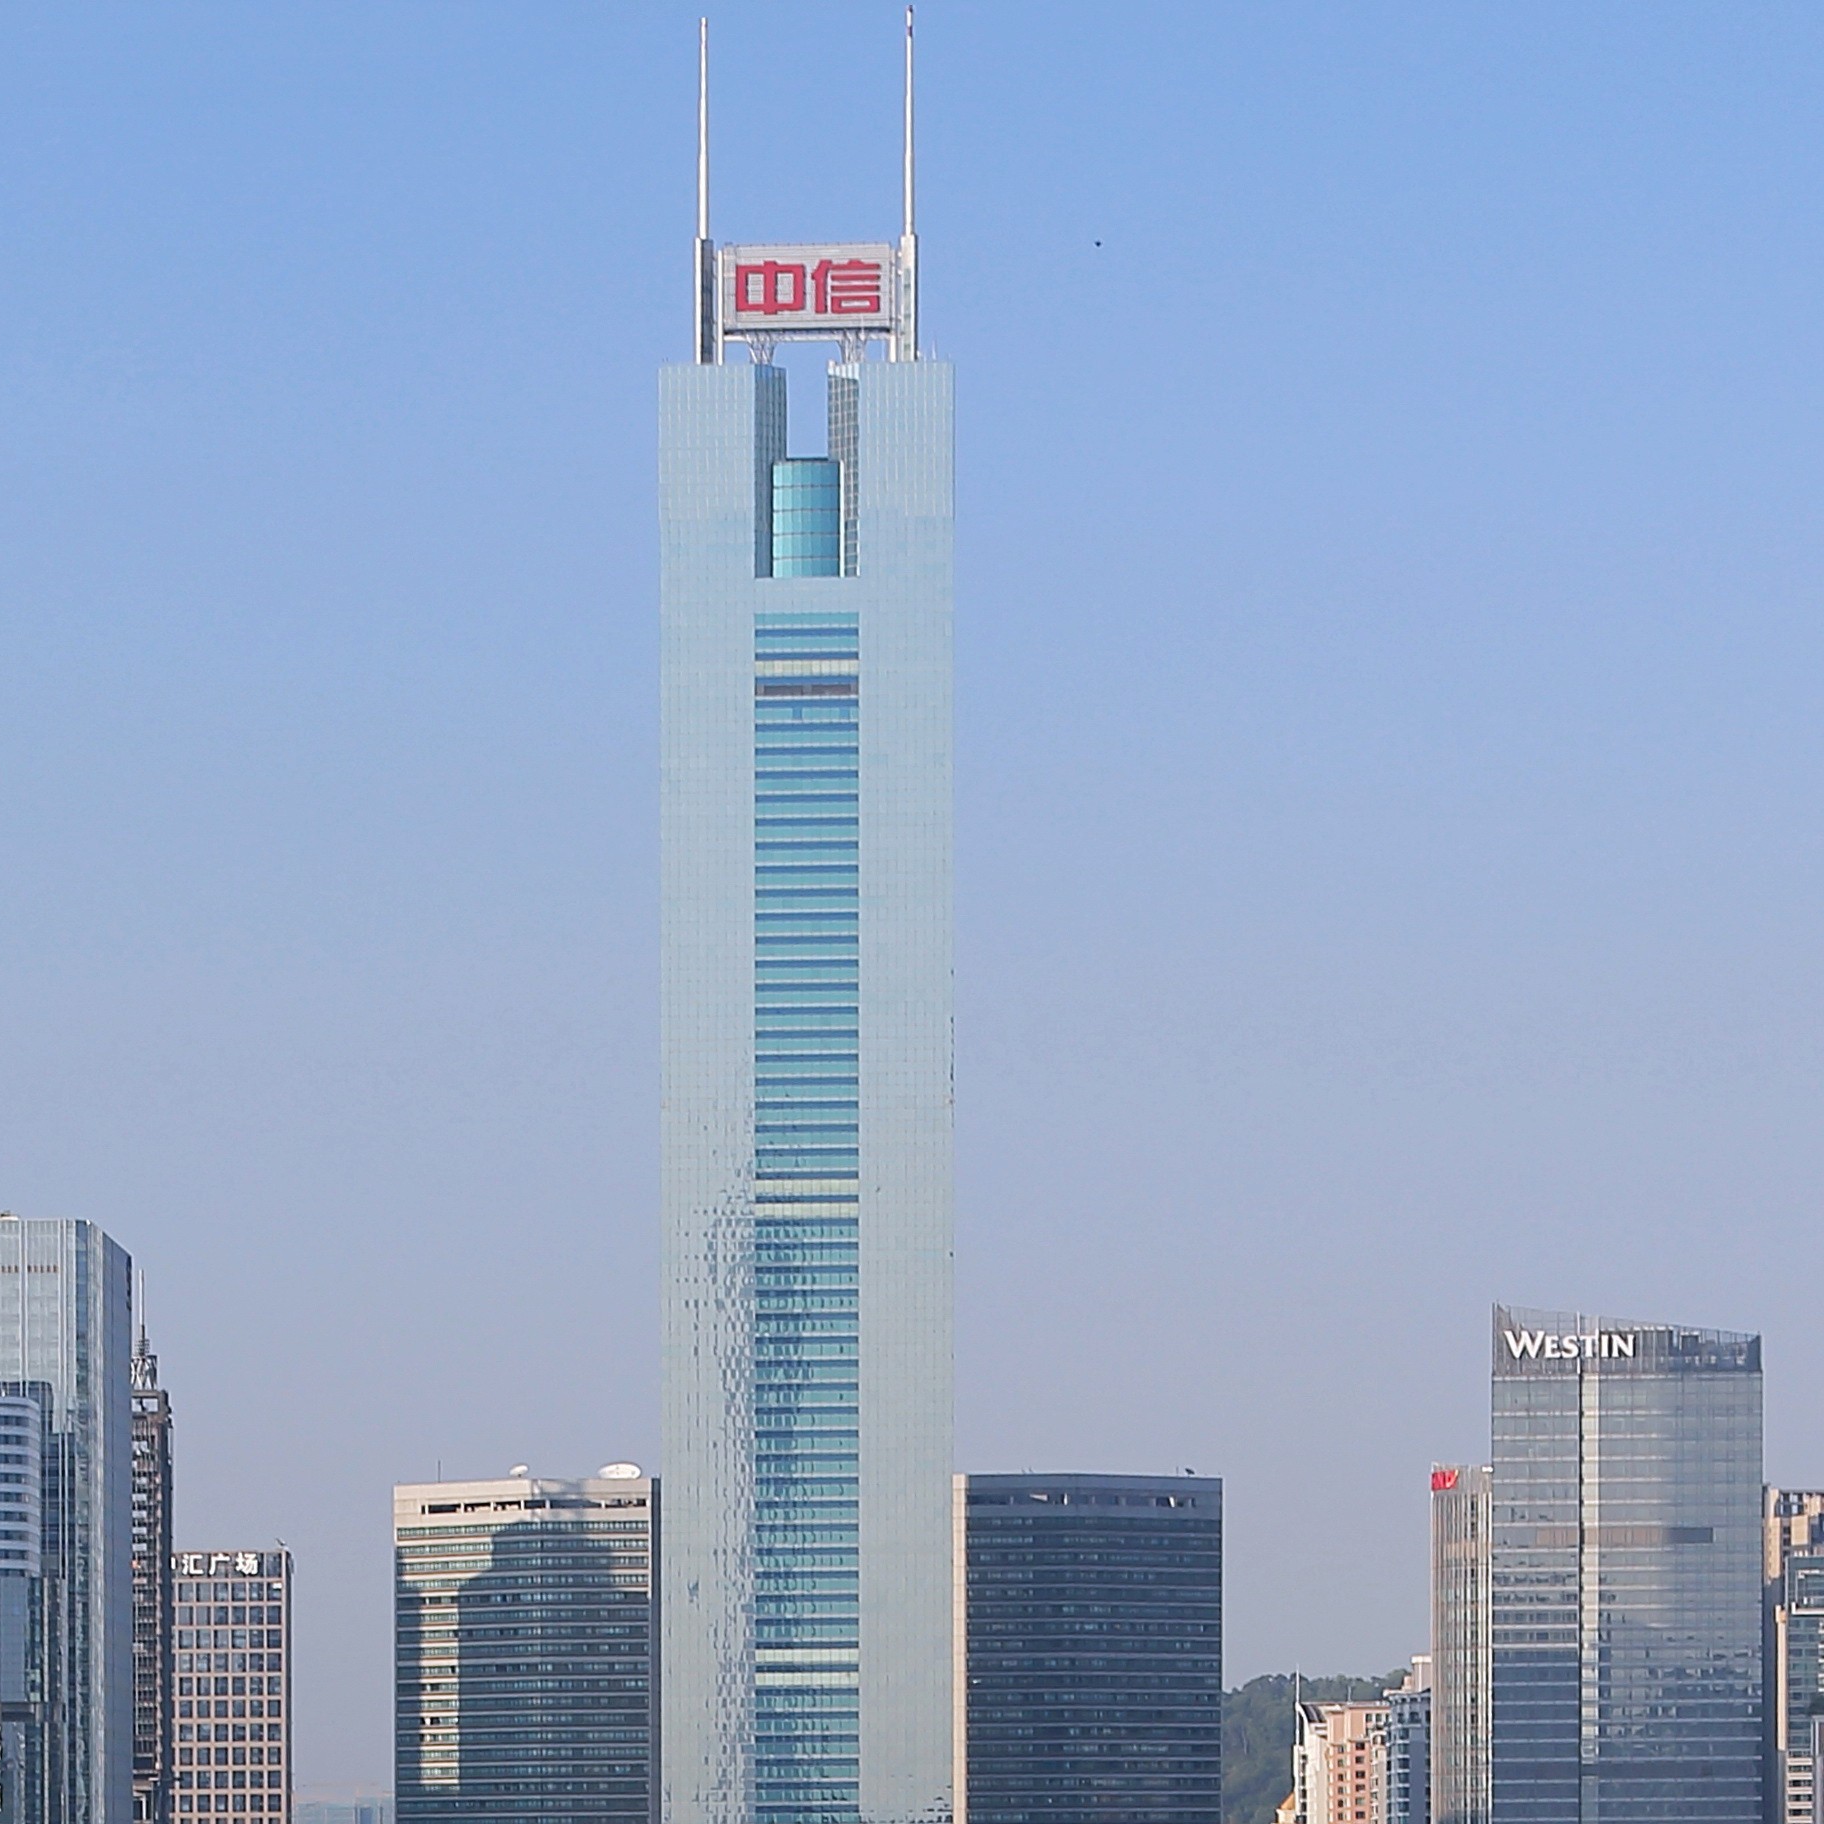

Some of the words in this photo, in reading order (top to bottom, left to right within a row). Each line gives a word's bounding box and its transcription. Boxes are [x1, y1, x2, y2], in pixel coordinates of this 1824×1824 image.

[735, 260, 881, 315] 中信
[171, 1551, 258, 1576] 汇广场
